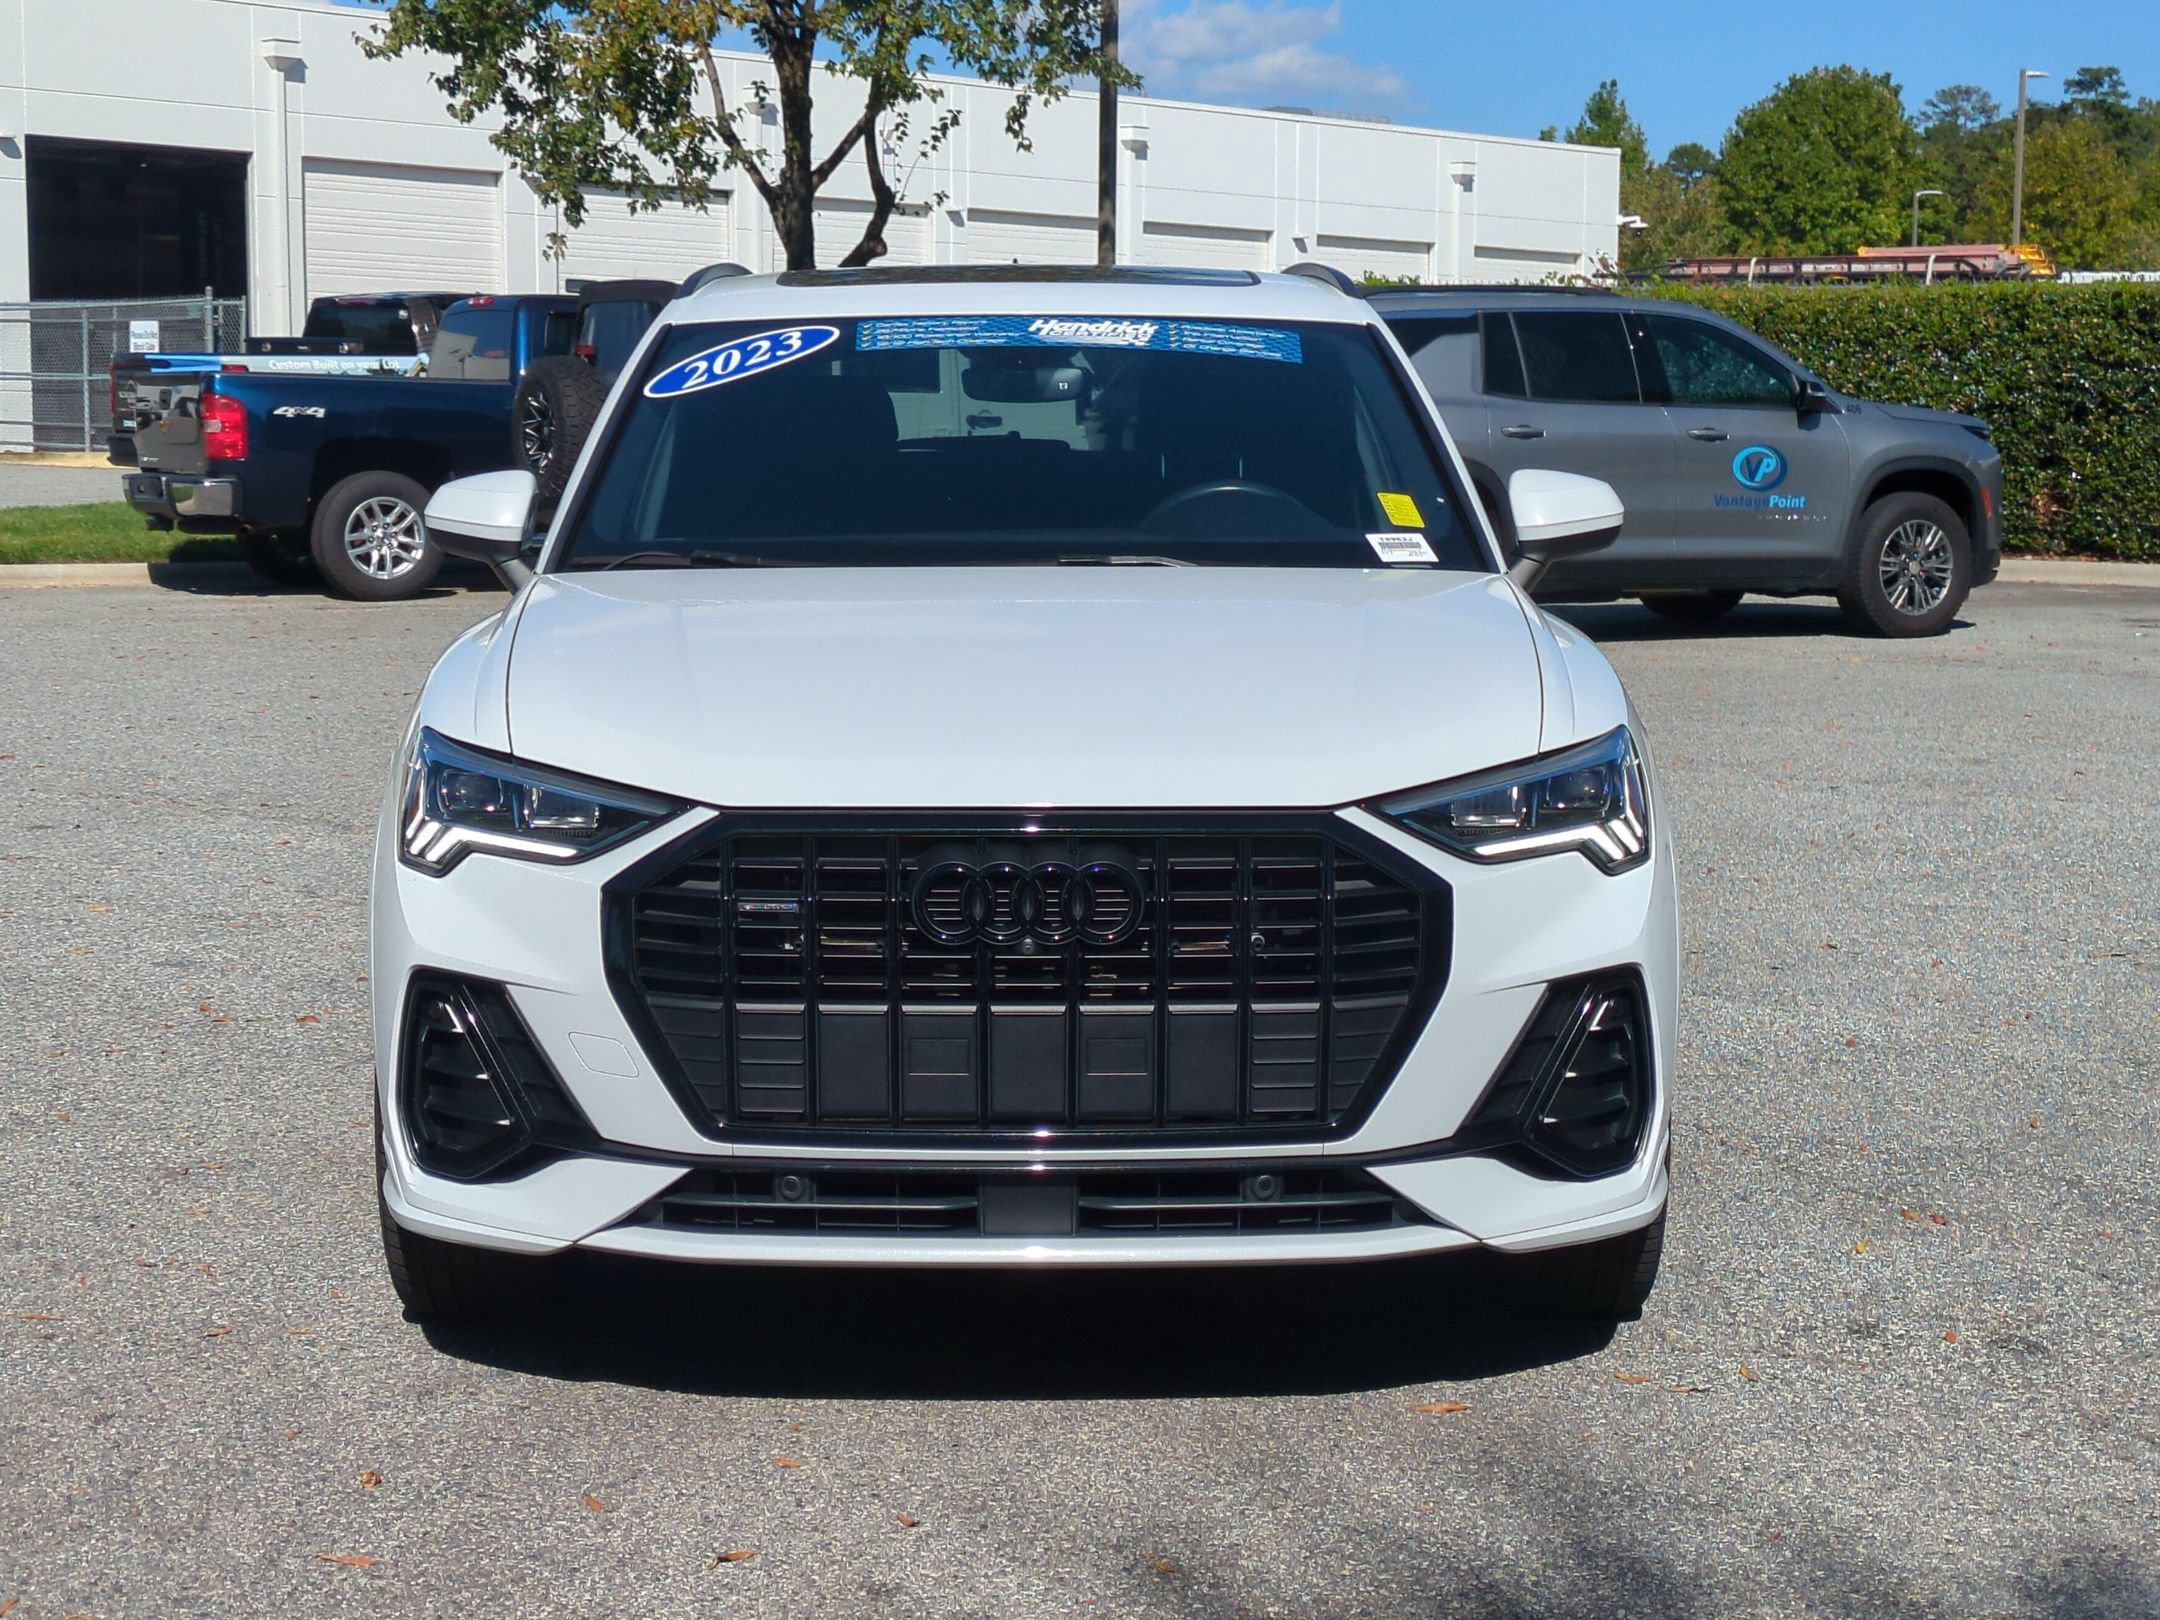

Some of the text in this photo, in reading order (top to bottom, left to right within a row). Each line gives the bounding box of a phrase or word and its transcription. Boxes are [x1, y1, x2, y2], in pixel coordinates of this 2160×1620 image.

[1028, 319, 1160, 336] Hendrick
[269, 360, 311, 370] Custom
[682, 331, 802, 390] 2023
[1744, 456, 1778, 482] VP
[1713, 493, 1807, 511] VantagePoint
